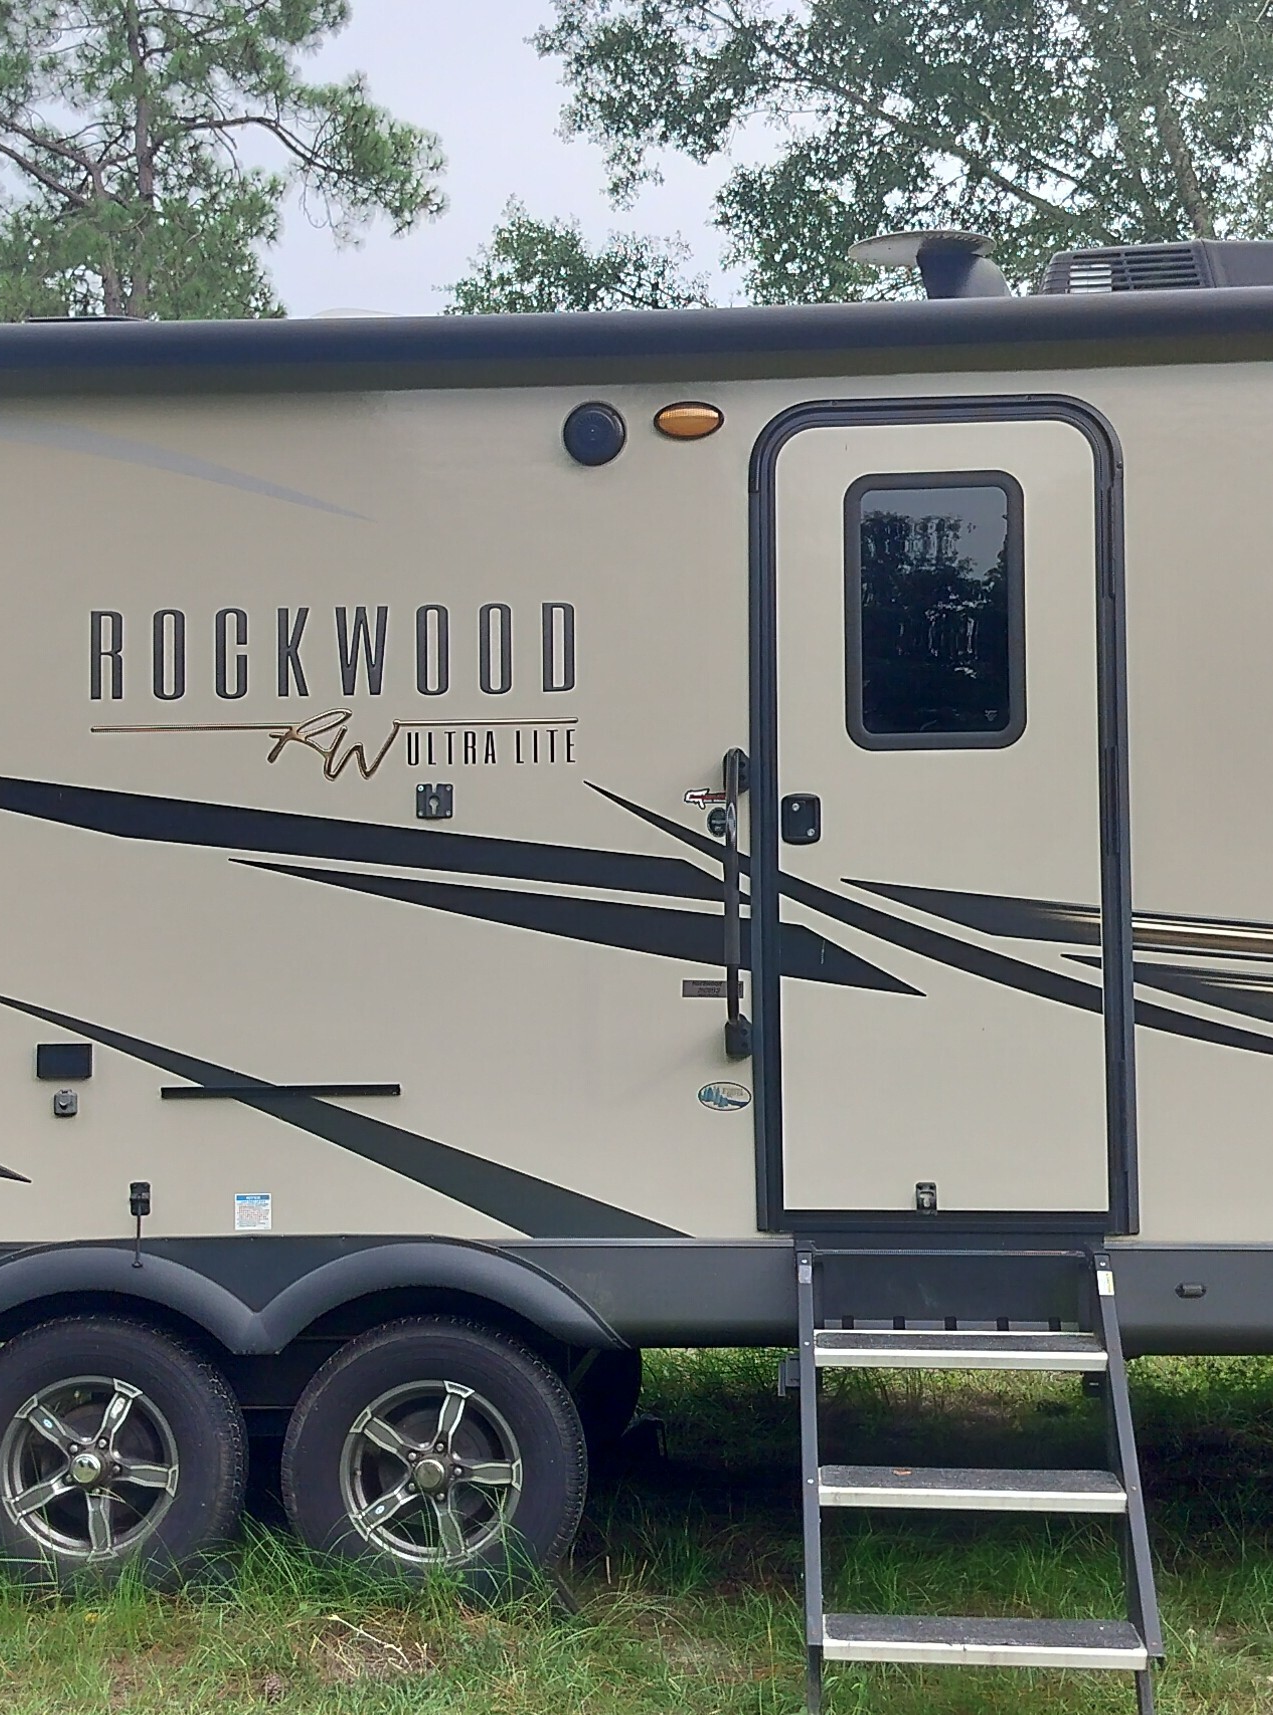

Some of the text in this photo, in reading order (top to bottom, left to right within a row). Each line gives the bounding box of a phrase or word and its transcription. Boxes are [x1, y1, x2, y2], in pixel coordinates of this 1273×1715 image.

[90, 602, 575, 701] ROCKWOOD
[407, 728, 577, 766] ULTRA LITE
